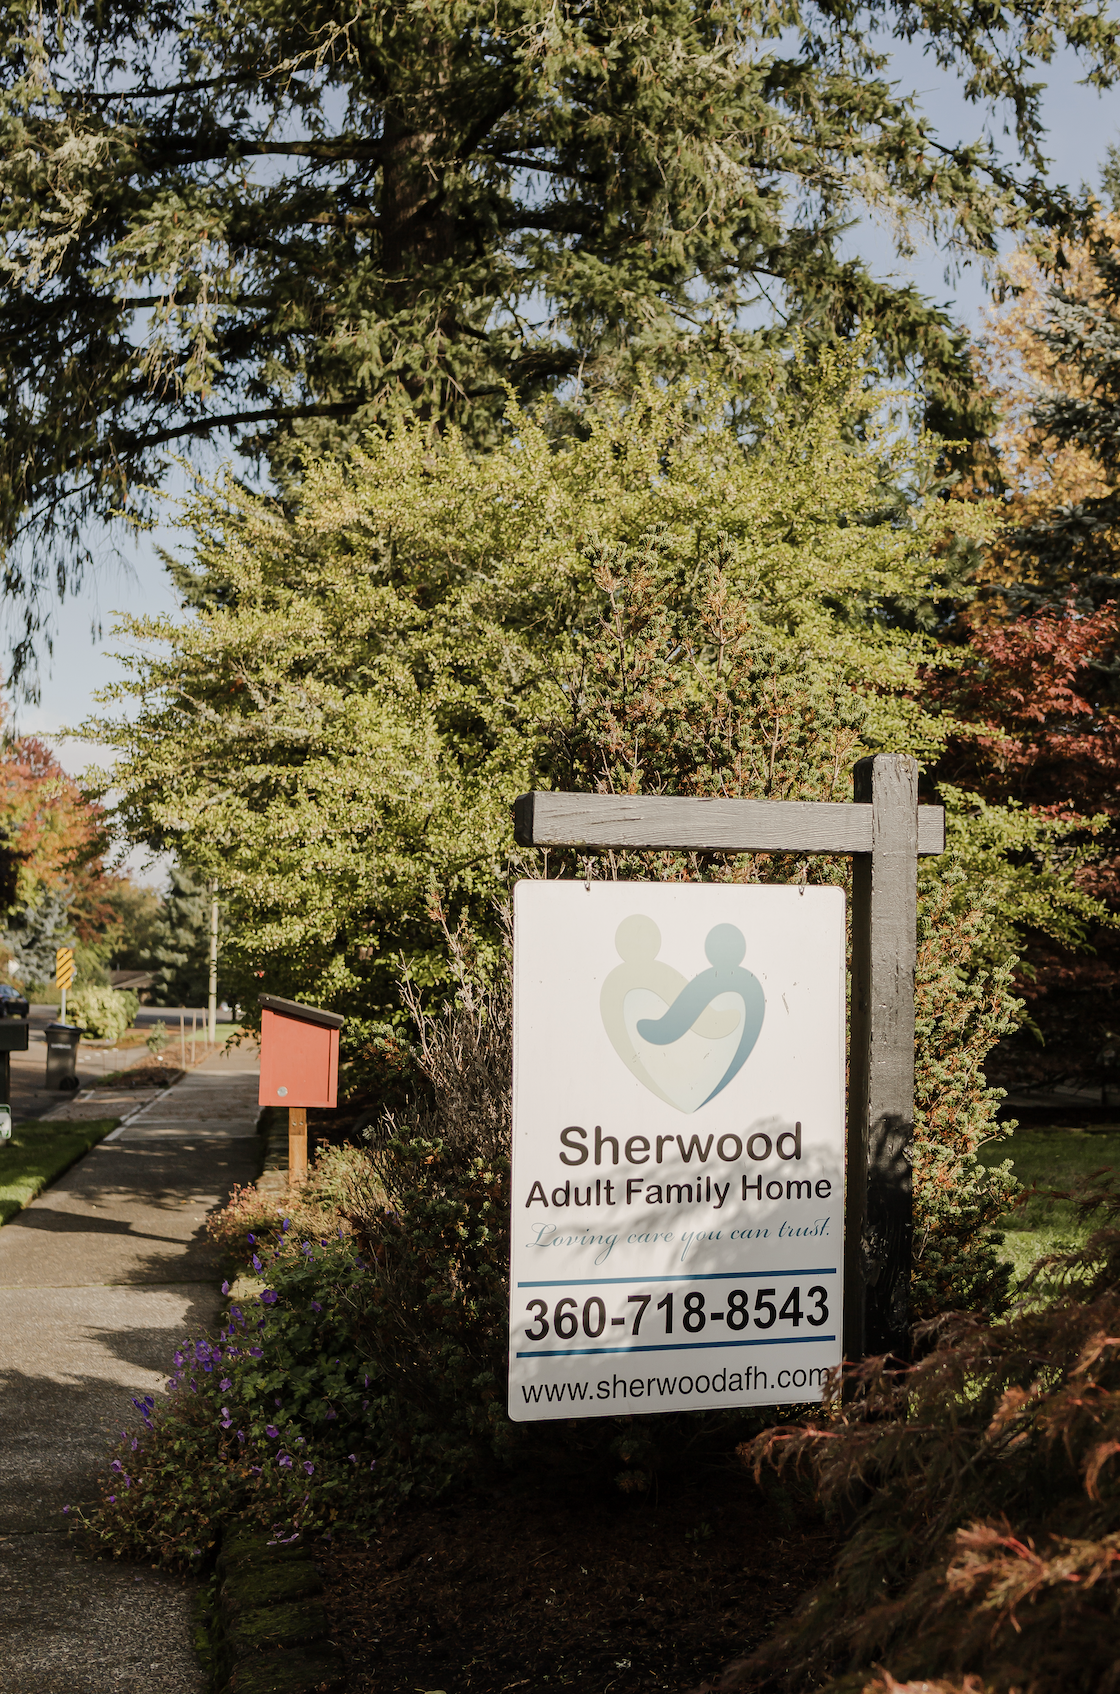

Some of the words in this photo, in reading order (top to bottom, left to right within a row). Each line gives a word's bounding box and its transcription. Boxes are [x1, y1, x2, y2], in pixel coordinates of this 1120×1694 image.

[559, 1121, 802, 1166] Sherwood
[525, 1179, 616, 1208] Adult
[626, 1176, 731, 1209] Family
[741, 1174, 832, 1201] Home
[525, 1222, 620, 1266] Loving
[627, 1231, 675, 1244] care
[680, 1230, 724, 1262] you
[730, 1228, 772, 1240] can
[778, 1216, 831, 1238] trust.
[524, 1285, 830, 1341] 360-718-8543
[521, 1365, 830, 1404] www.sherwoodafh.com
